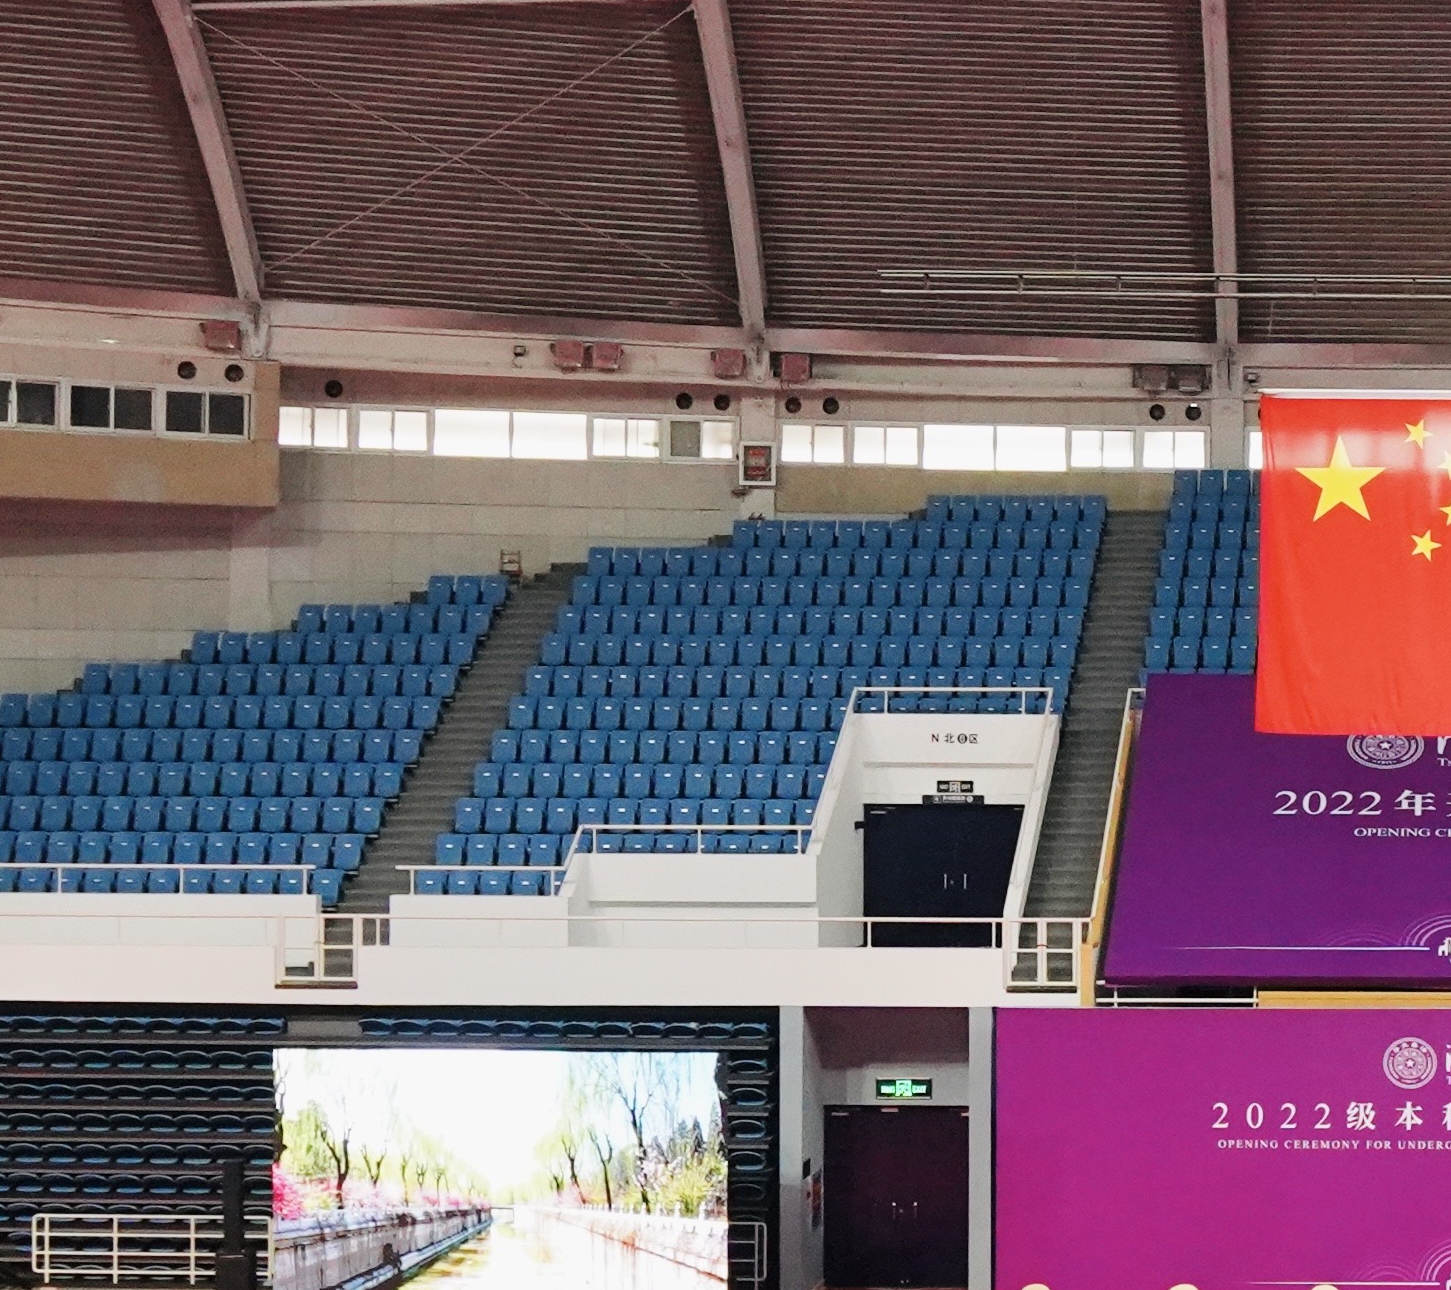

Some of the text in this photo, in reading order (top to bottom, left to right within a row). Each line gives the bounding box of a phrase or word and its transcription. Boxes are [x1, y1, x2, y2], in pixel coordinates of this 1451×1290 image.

[1353, 827, 1431, 838] OPENING
[1217, 1140, 1279, 1151] OPENING
[1283, 1140, 1360, 1151] CEREMONY
[1365, 1140, 1392, 1151] FOR
